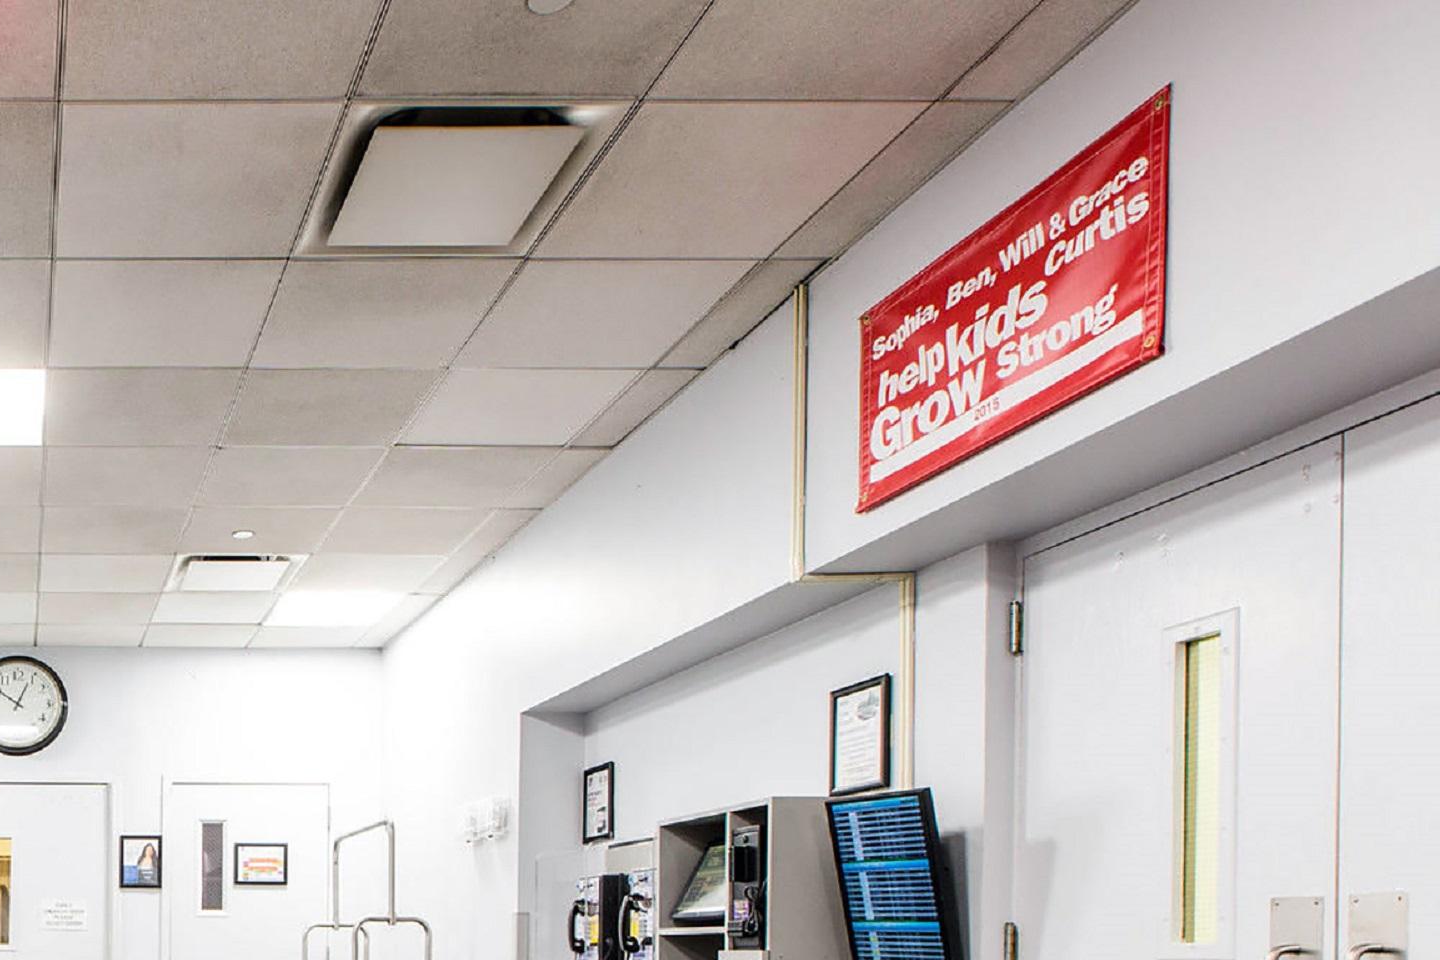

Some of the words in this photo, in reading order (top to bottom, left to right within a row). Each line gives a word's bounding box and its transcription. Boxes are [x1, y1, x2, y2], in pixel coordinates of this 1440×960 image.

[872, 304, 940, 361] Sophia,
[945, 266, 997, 310] Ben,
[998, 221, 1045, 273] Will
[1048, 212, 1066, 241] &
[1068, 156, 1149, 227] Grace
[1044, 191, 1150, 277] Curtis
[878, 341, 945, 409] help
[945, 280, 1049, 377] kids
